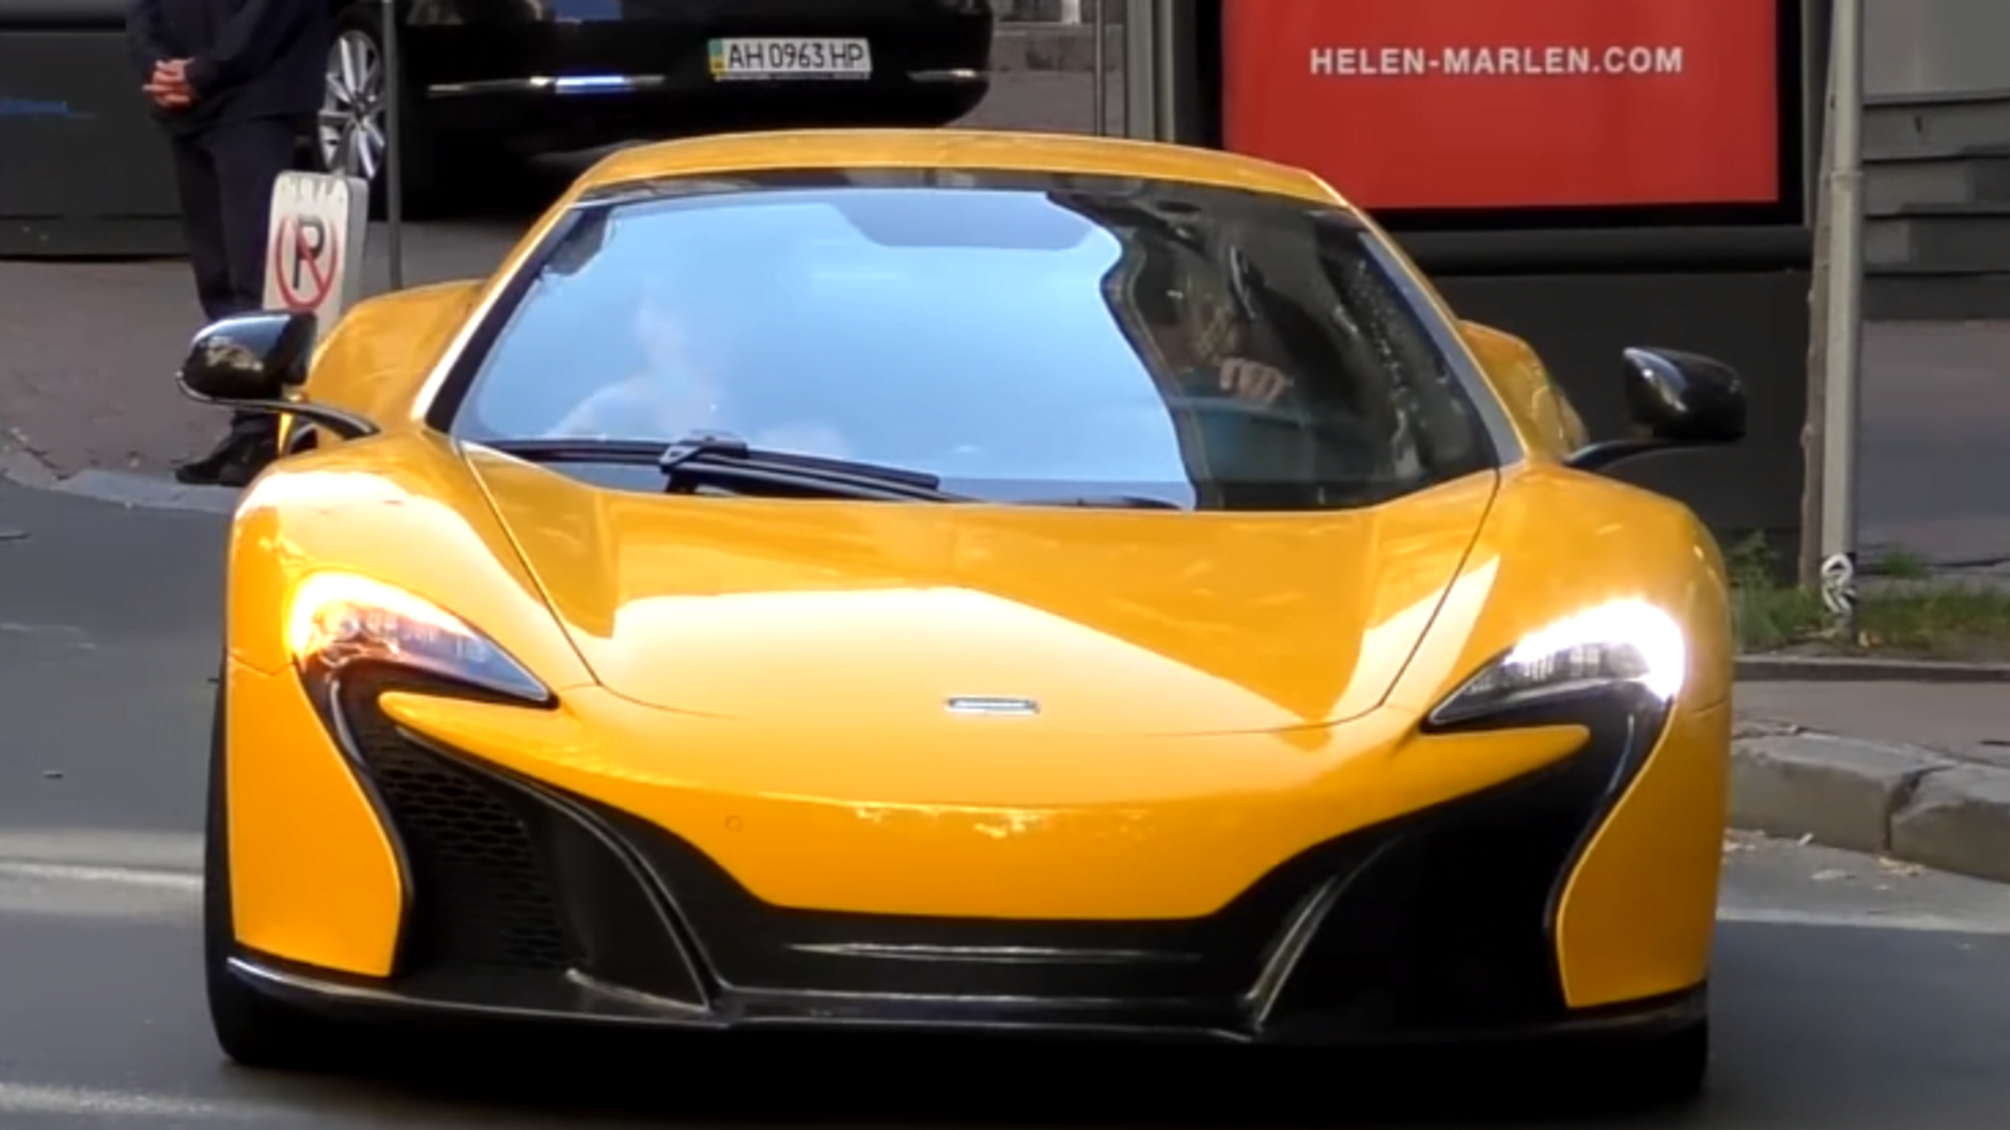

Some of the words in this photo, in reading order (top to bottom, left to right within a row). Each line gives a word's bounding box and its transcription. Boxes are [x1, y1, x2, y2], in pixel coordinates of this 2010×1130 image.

[729, 43, 764, 68] AH
[769, 43, 825, 68] 0963
[830, 43, 864, 68] HP
[1309, 46, 1683, 74] HELEN-MARLEN.COM
